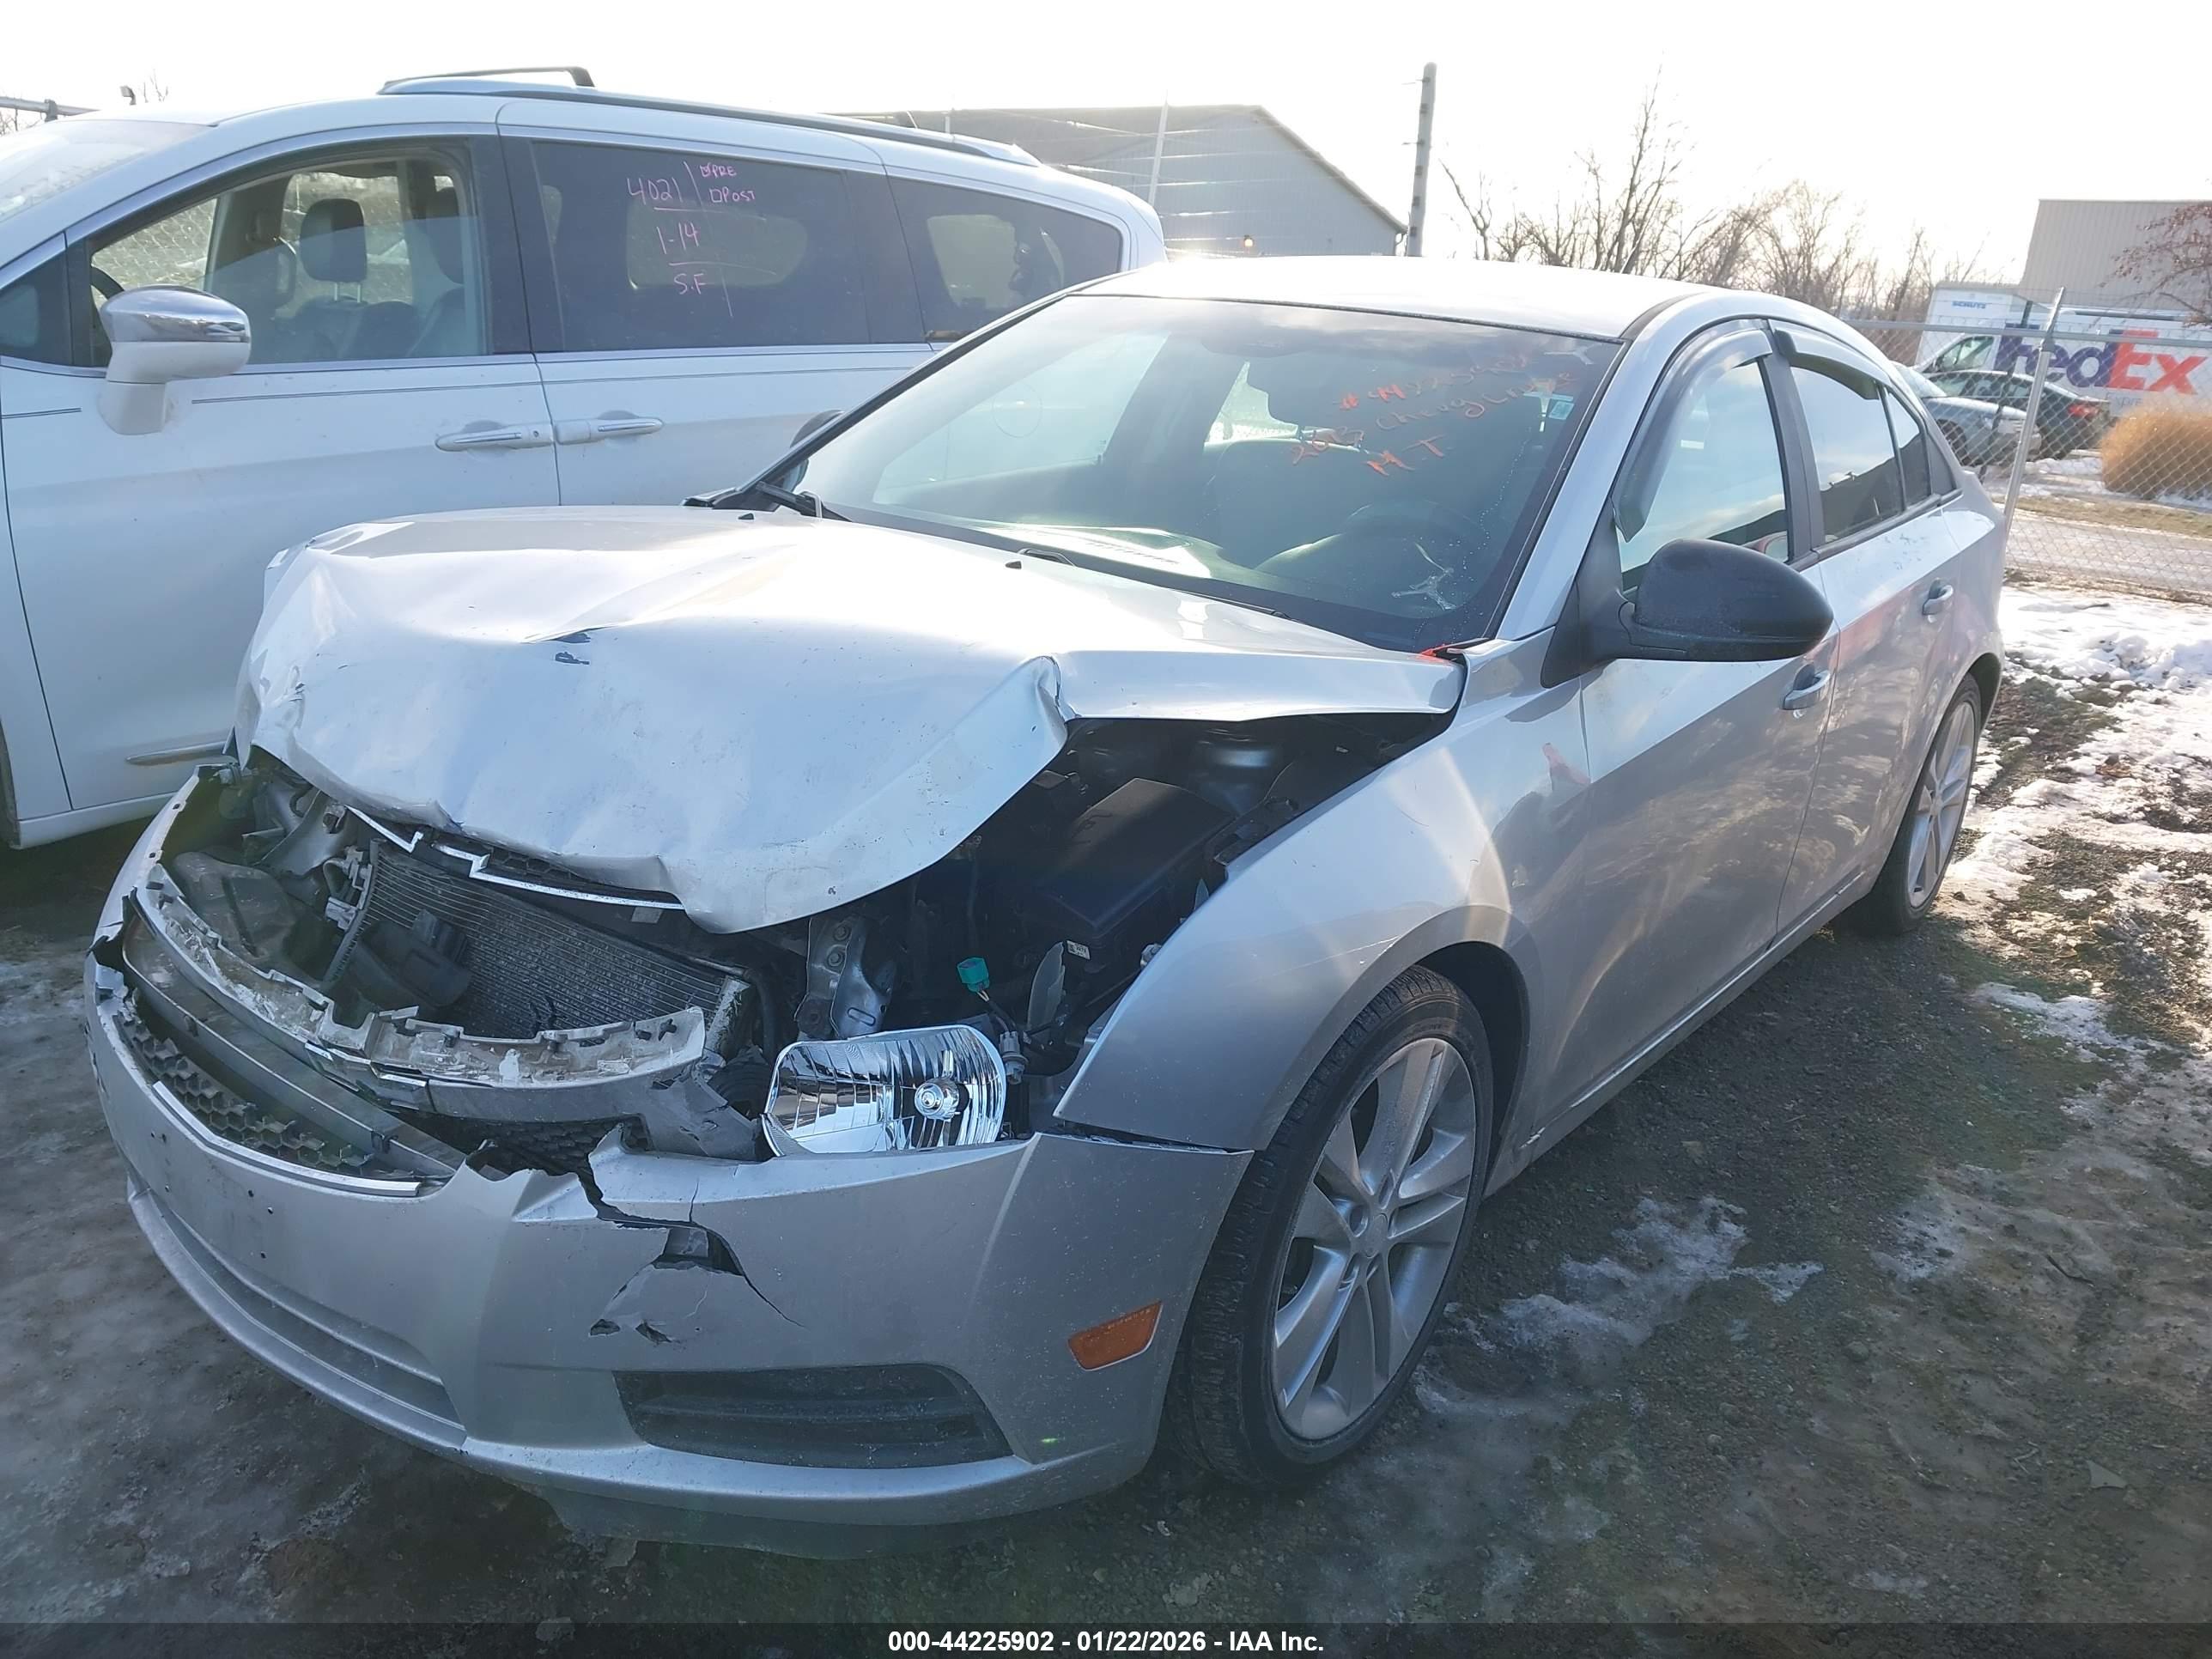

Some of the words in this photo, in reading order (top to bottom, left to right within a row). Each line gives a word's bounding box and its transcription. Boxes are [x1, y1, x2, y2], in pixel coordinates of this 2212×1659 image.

[627, 177, 684, 205] 4021
[722, 185, 756, 204] POST
[1994, 323, 2209, 395] FedEx
